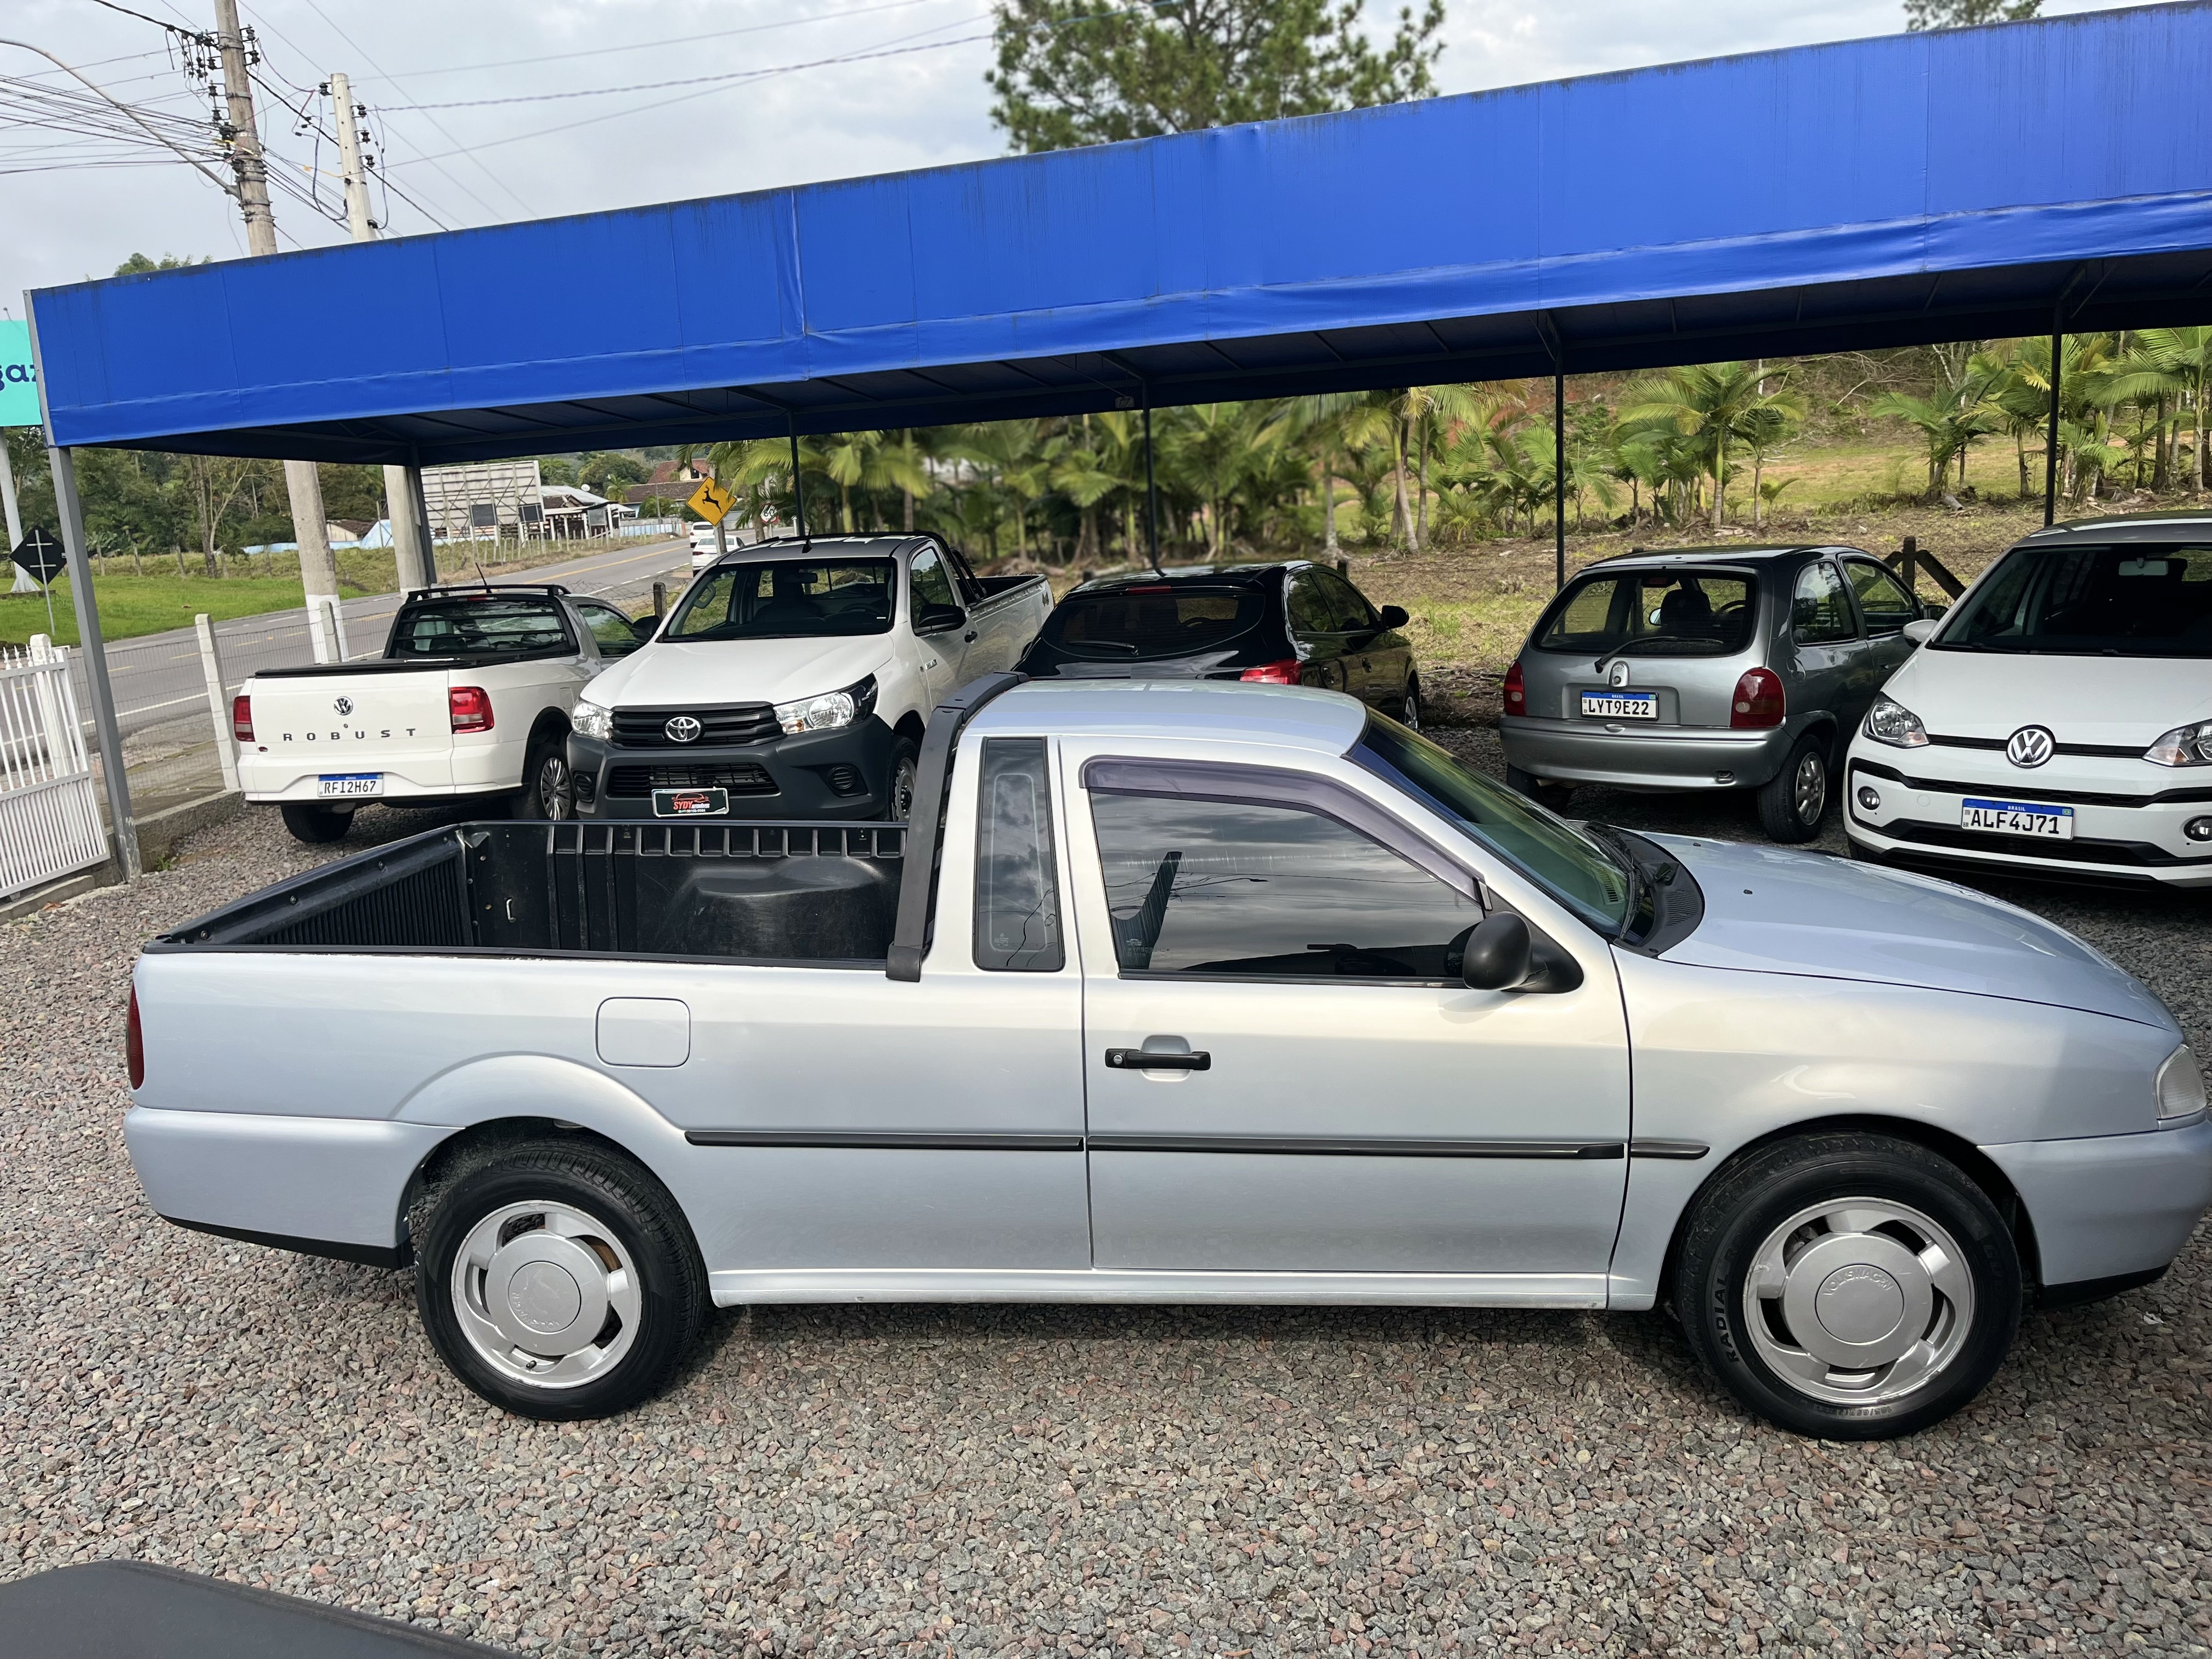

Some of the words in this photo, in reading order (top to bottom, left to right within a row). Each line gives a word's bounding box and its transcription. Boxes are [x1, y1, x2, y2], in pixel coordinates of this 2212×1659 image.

[1588, 699, 1649, 715] LYT9E22
[283, 728, 416, 741] ROBUST
[324, 780, 376, 794] RFI2H67
[673, 801, 693, 810] SYDY
[1970, 809, 2059, 834] ALF4J71
[1709, 1274, 1740, 1363] RADIAL
